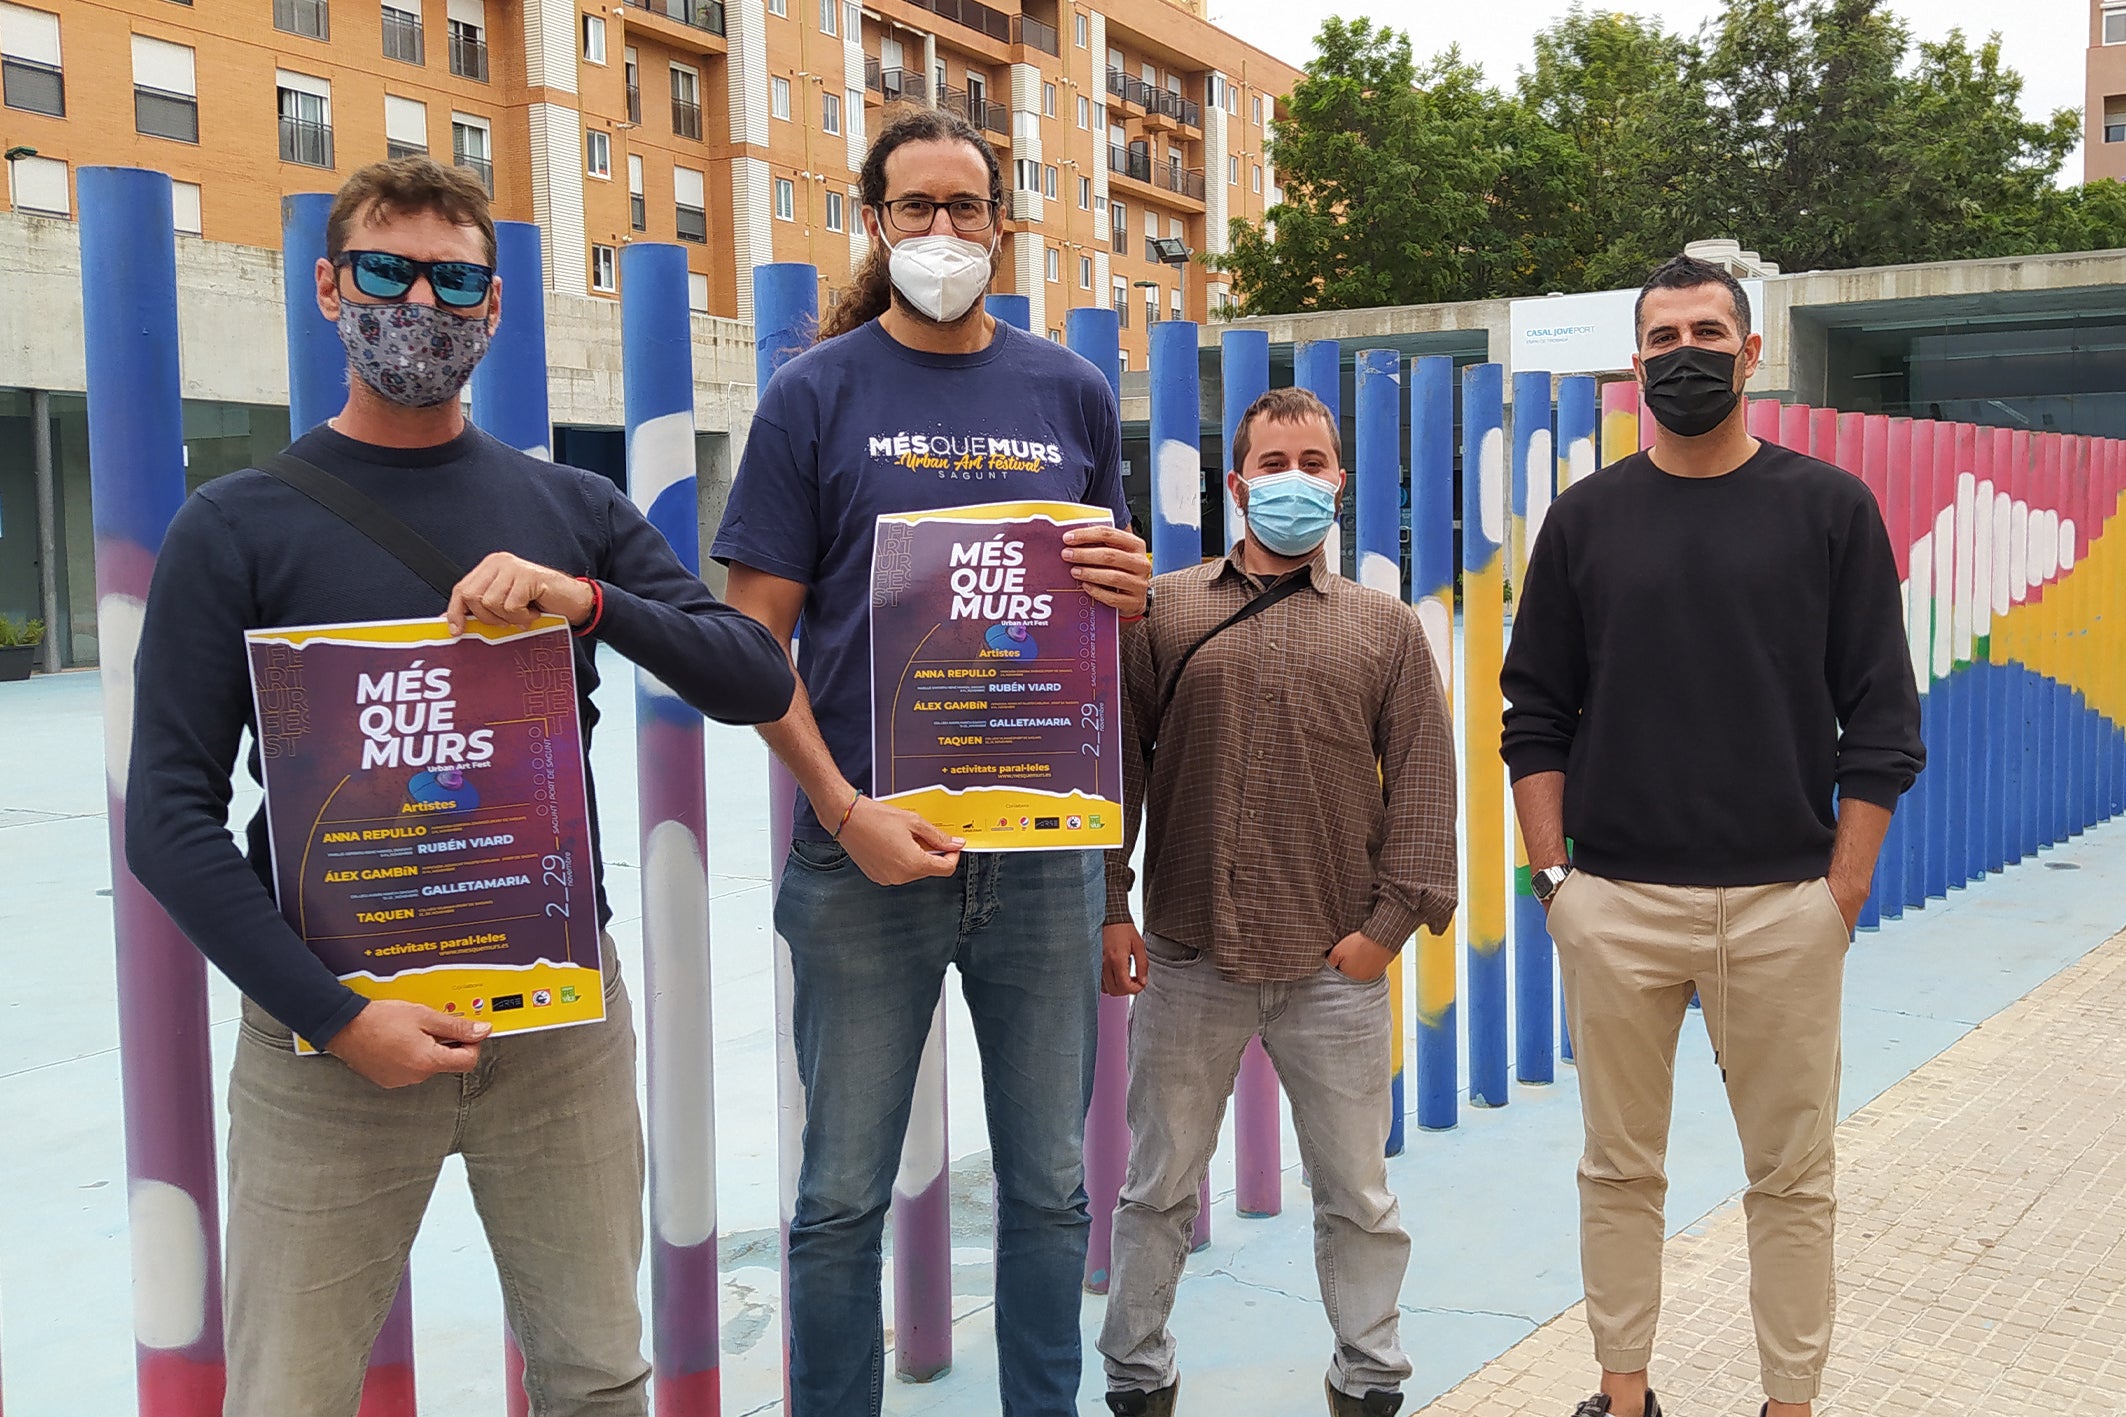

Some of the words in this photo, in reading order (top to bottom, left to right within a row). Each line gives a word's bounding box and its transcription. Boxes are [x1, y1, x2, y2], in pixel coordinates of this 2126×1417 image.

[1526, 328, 1552, 337] CASAL
[954, 453, 983, 472] Art
[949, 533, 1025, 567] MÉS
[950, 567, 1027, 599] QUE
[950, 594, 1054, 620] MURS
[978, 648, 1021, 658] Artistes
[914, 669, 945, 678] ANNA
[947, 668, 997, 678] REPULLO
[356, 659, 452, 705] MÉS
[989, 682, 1026, 692] RUBÉN
[1027, 683, 1062, 692] VIARD
[914, 700, 942, 711] ÁLEX
[359, 700, 456, 743] QUE
[989, 717, 1072, 727] GALLETAMARIA
[361, 729, 495, 770] MURS
[937, 736, 983, 746] TAQUEN
[544, 739, 556, 768] SAGUNT
[427, 764, 455, 773] Urban
[456, 762, 472, 771] Art
[472, 760, 492, 769] Fest
[547, 768, 556, 779] DE
[950, 764, 997, 774] activitats
[548, 779, 558, 803] PORT
[402, 800, 457, 813] Artistes
[551, 809, 561, 835] SAGUNT
[322, 831, 361, 843] ANNA
[362, 825, 427, 841] REPULLO
[417, 838, 467, 854] RUBÉN
[468, 834, 514, 848] VIARD
[324, 870, 360, 883] ÁLEX
[565, 851, 575, 888] novembre
[421, 874, 531, 897] GALLETAMARIA
[356, 908, 415, 923] TAQUEN
[375, 940, 437, 957] activitats
